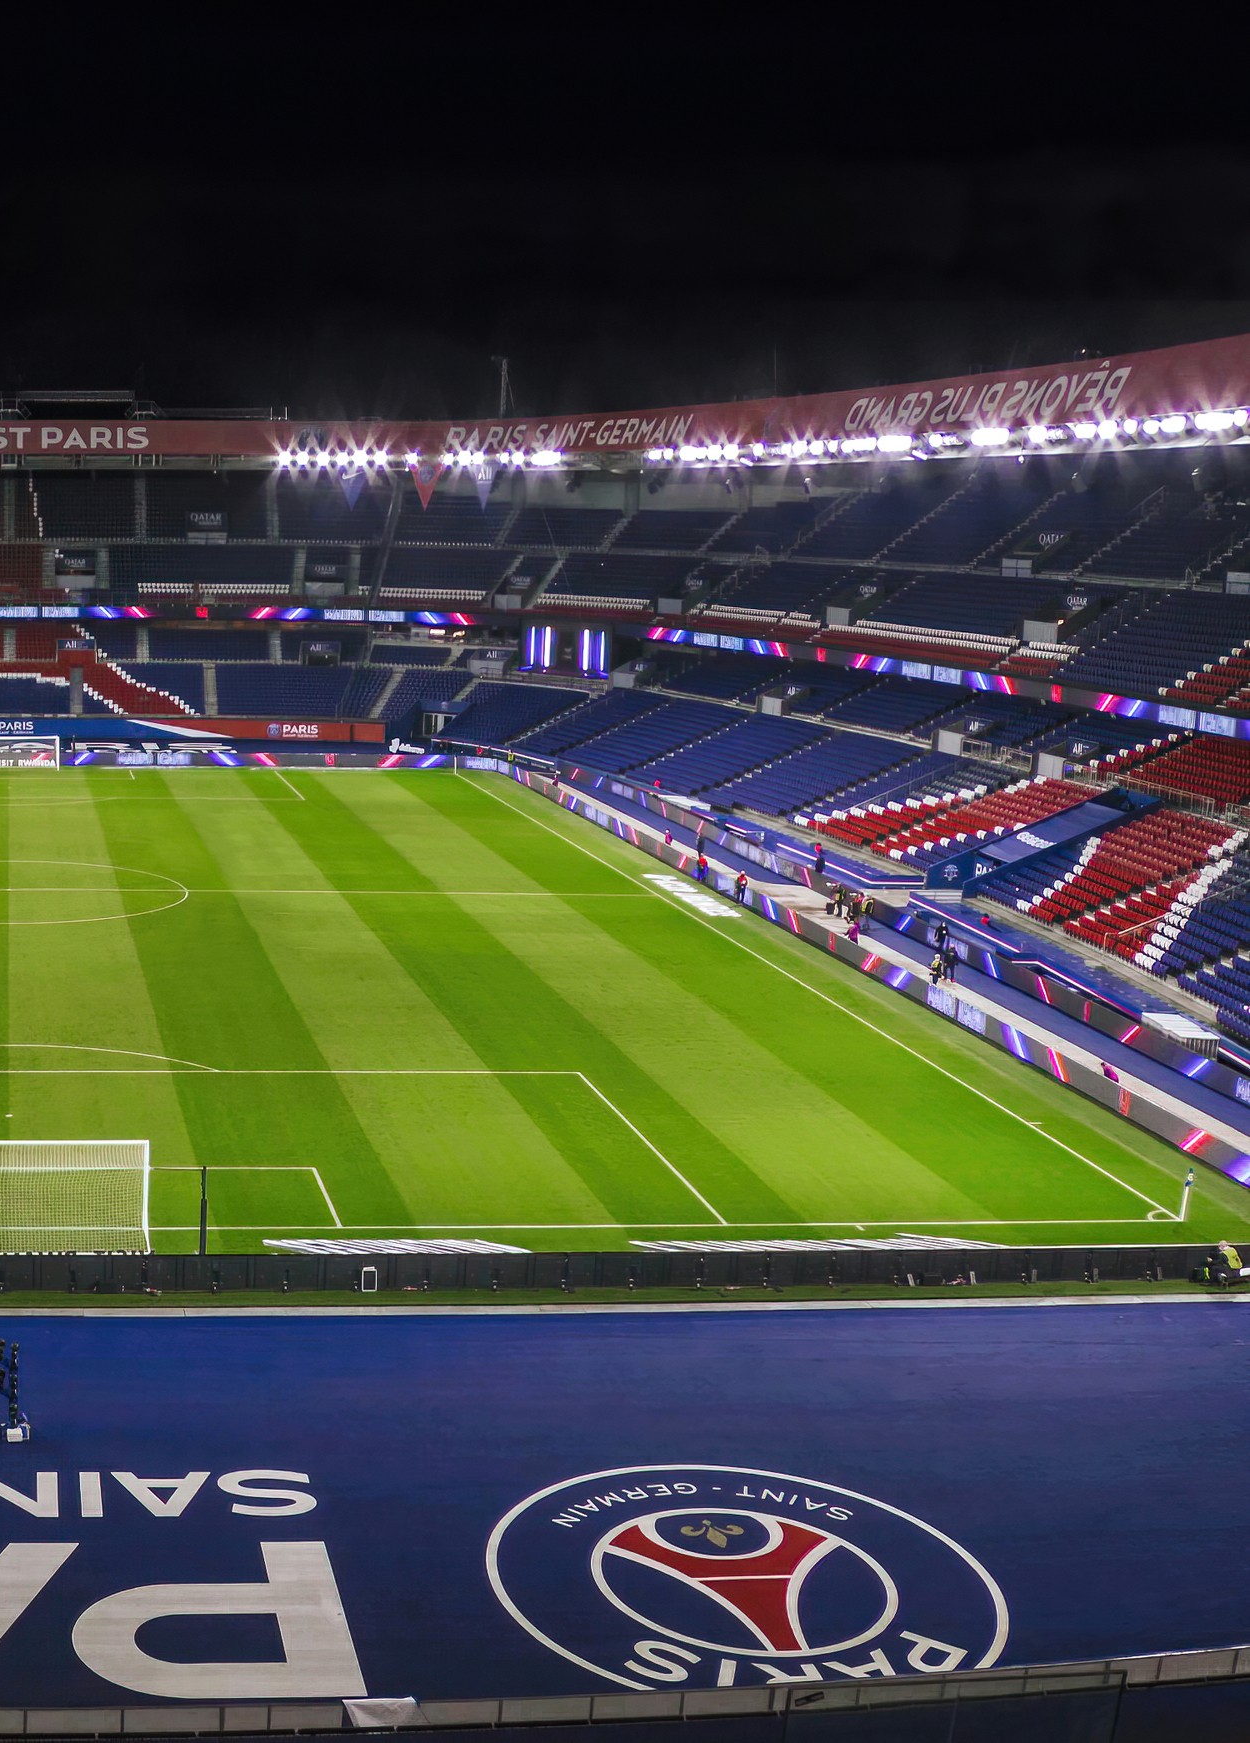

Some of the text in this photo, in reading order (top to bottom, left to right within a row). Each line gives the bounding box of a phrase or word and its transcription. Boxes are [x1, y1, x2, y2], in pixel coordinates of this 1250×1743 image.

[41, 427, 149, 450] PARIS
[442, 414, 694, 449] PARIS SAINT-GERMAIN
[190, 513, 222, 523] QATAR
[282, 724, 319, 734] PARIS
[551, 1482, 698, 1529] GERMAIN
[736, 1484, 854, 1523] SAINT
